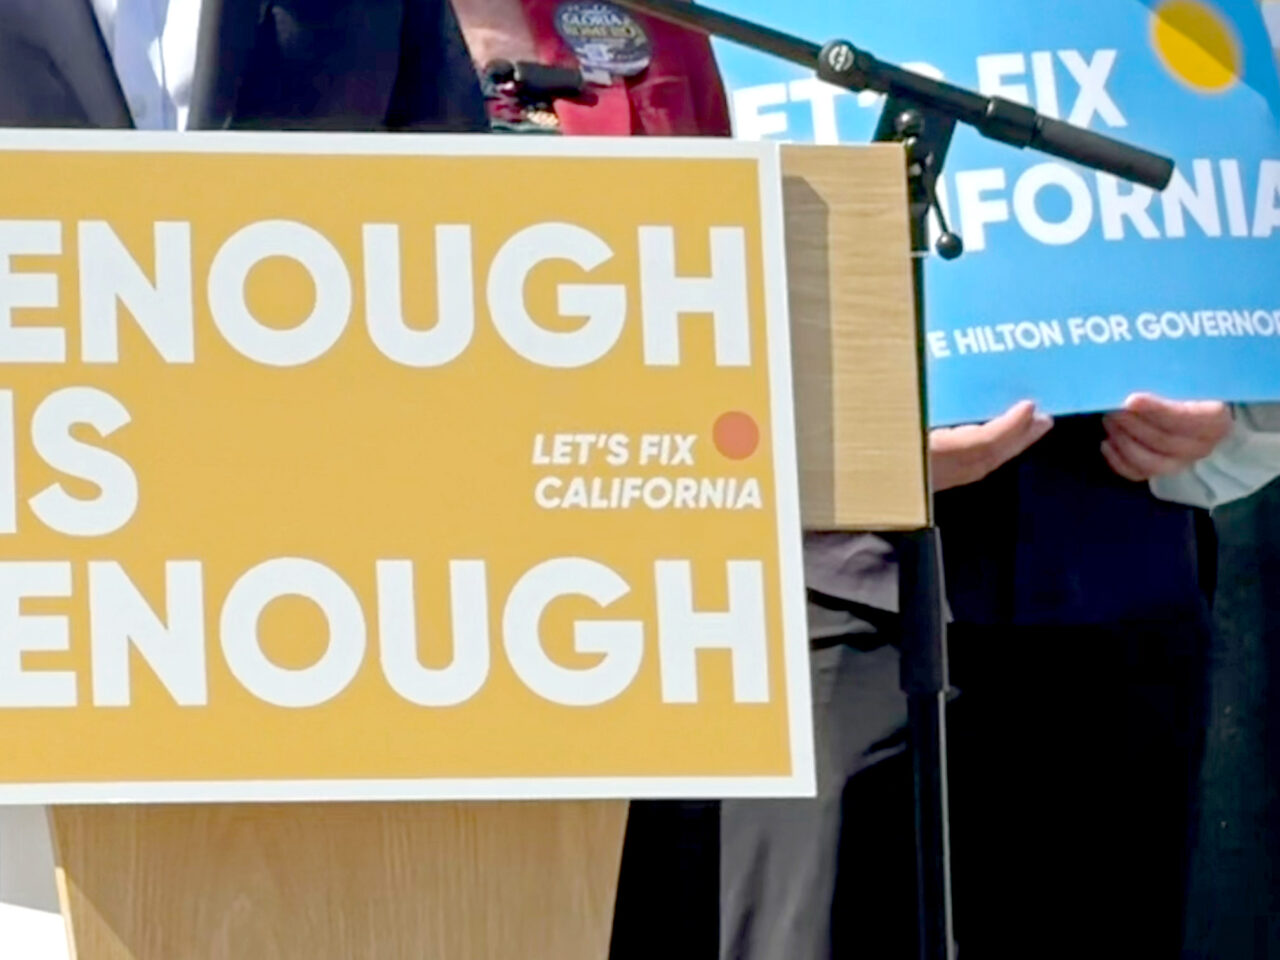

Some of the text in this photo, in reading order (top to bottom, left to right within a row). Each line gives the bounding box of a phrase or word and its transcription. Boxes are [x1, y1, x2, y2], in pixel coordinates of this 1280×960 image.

[953, 319, 1065, 355] HILTON
[1069, 313, 1129, 345] FOR
[531, 433, 698, 467] LET'S FIX
[534, 476, 763, 510] CALIFORNIA
